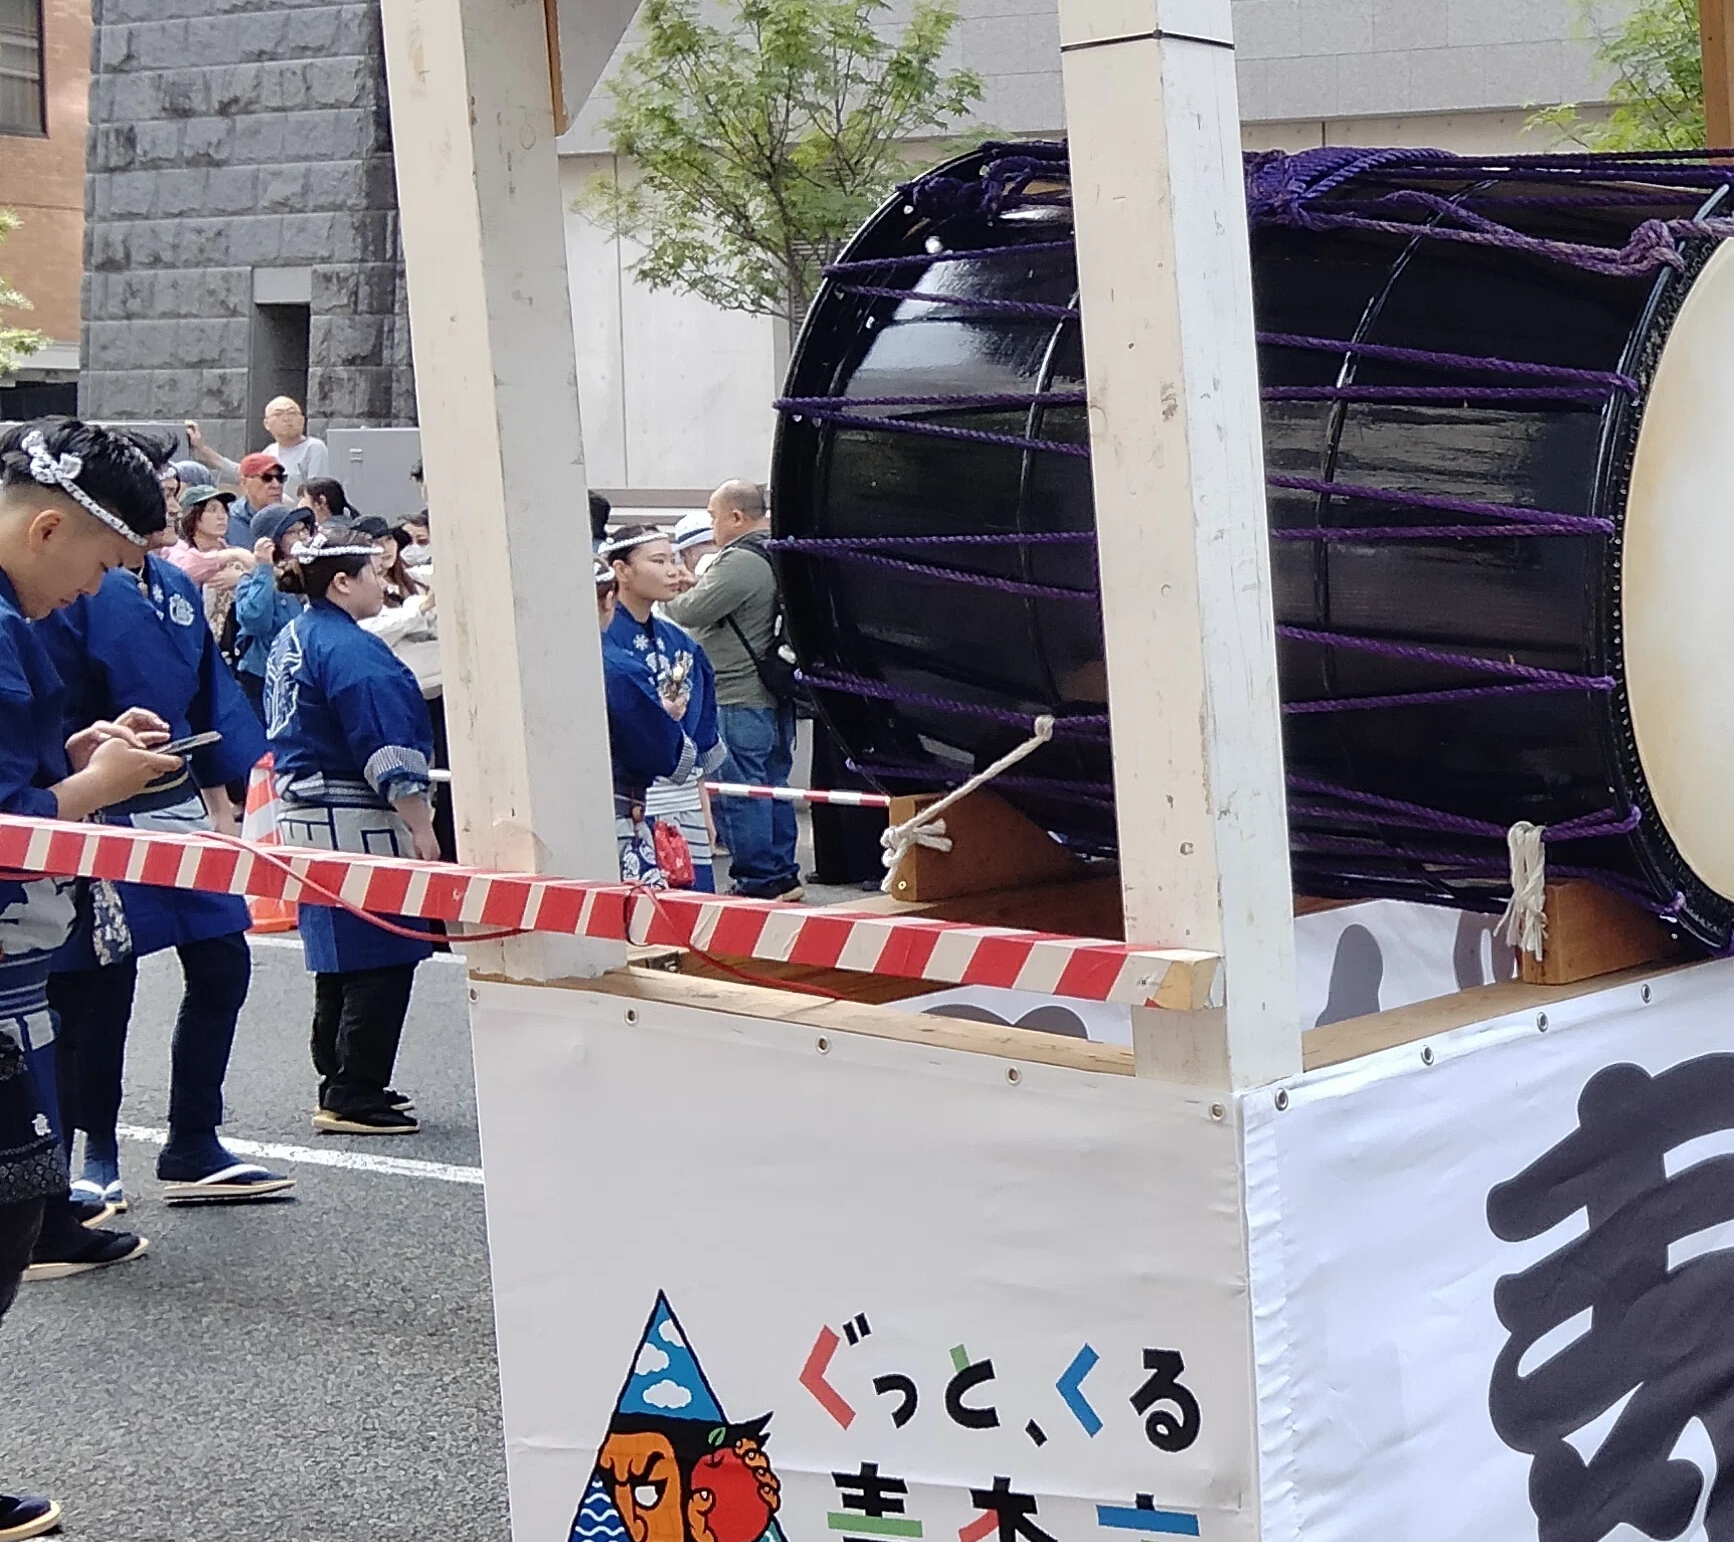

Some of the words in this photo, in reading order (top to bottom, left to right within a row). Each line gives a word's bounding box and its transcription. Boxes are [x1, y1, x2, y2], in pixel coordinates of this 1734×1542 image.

[798, 1312, 1203, 1454] ぐっと、くる
